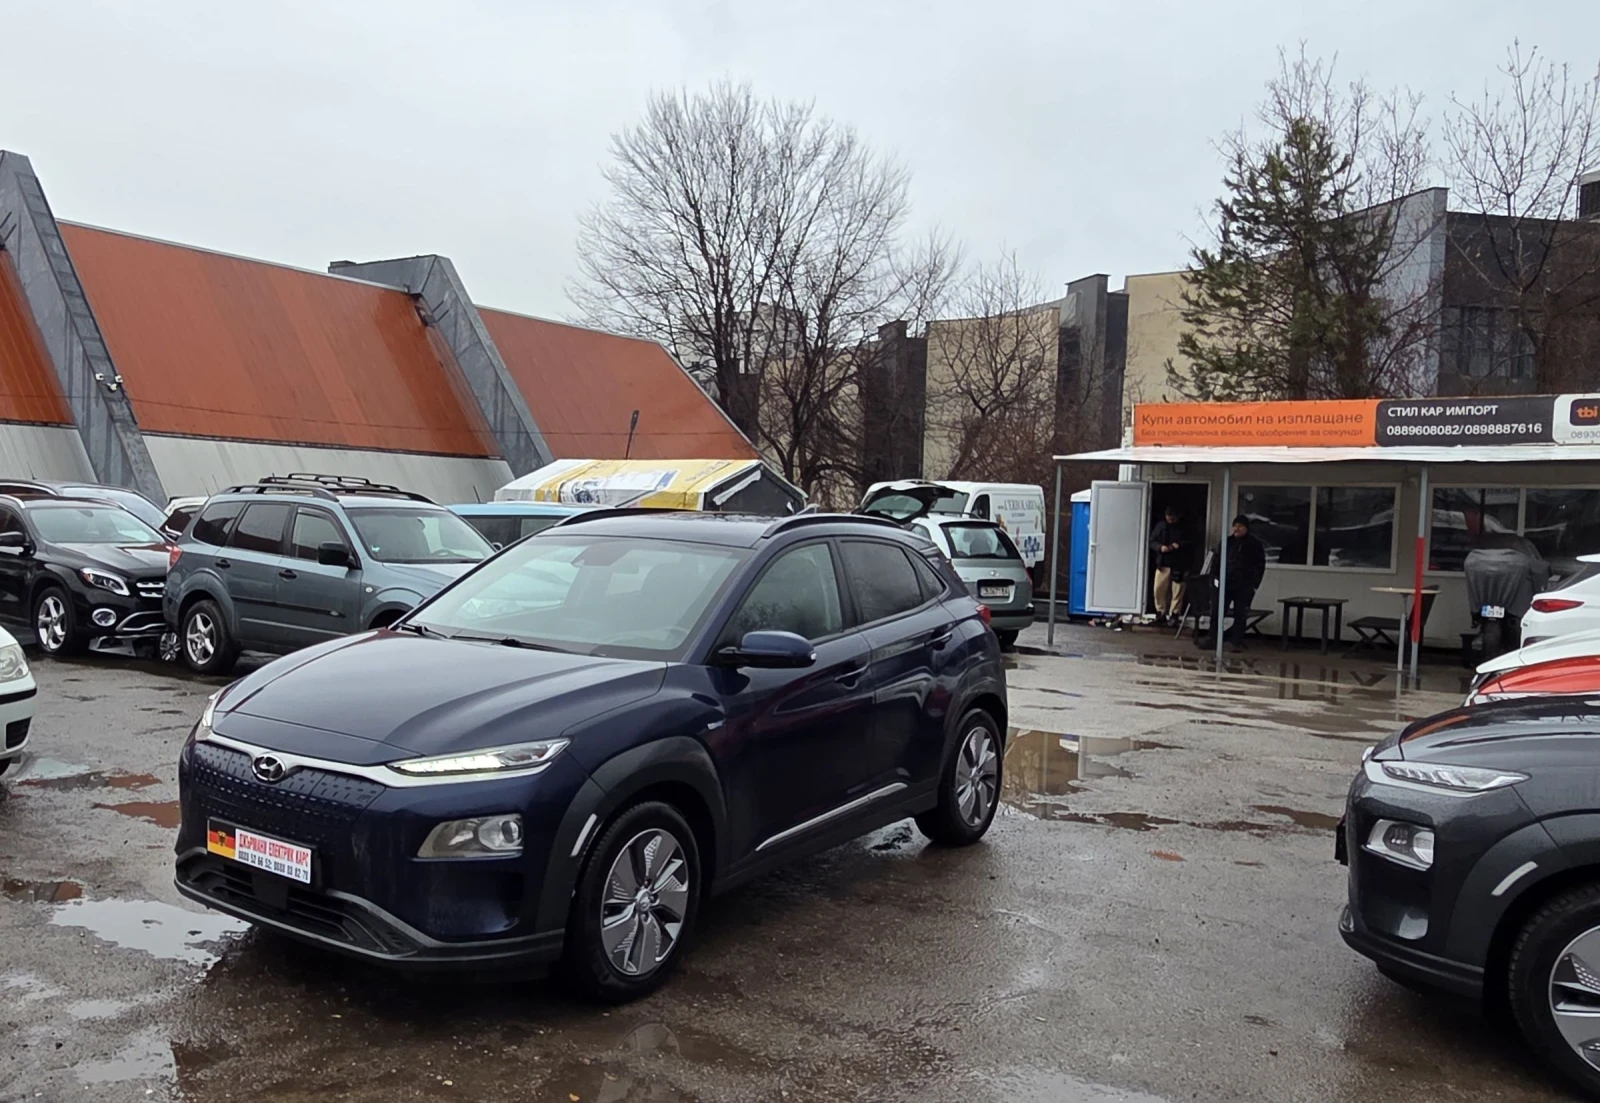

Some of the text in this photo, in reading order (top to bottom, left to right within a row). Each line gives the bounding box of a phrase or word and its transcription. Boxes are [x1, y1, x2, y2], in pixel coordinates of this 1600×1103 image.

[1388, 405, 1498, 417] СТИЛ КАР ИМПОРТ
[1576, 406, 1598, 418] tbi
[1141, 413, 1364, 427] Купи автомобил на изплащане
[1322, 428, 1363, 438] секунди
[1386, 423, 1542, 435] 0889608082/0898887616
